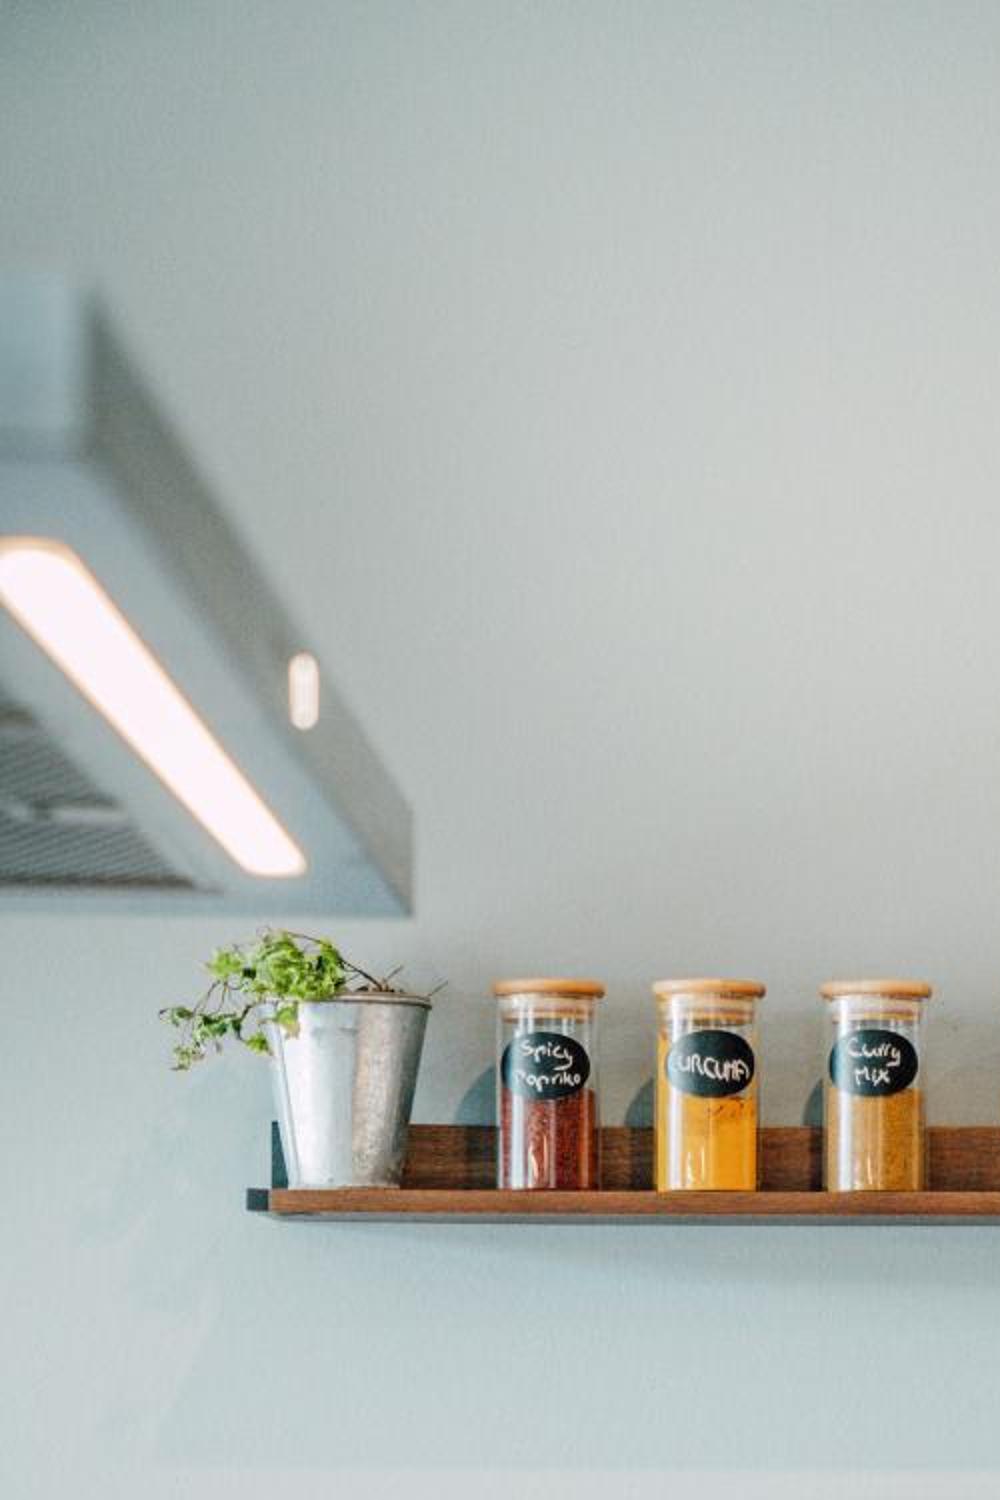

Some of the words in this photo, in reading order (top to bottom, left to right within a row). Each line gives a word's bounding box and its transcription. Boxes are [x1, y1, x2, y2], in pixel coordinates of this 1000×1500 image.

[520, 1039, 573, 1071] Spicy
[848, 1036, 901, 1067] Curry
[854, 1067, 891, 1087] Mix
